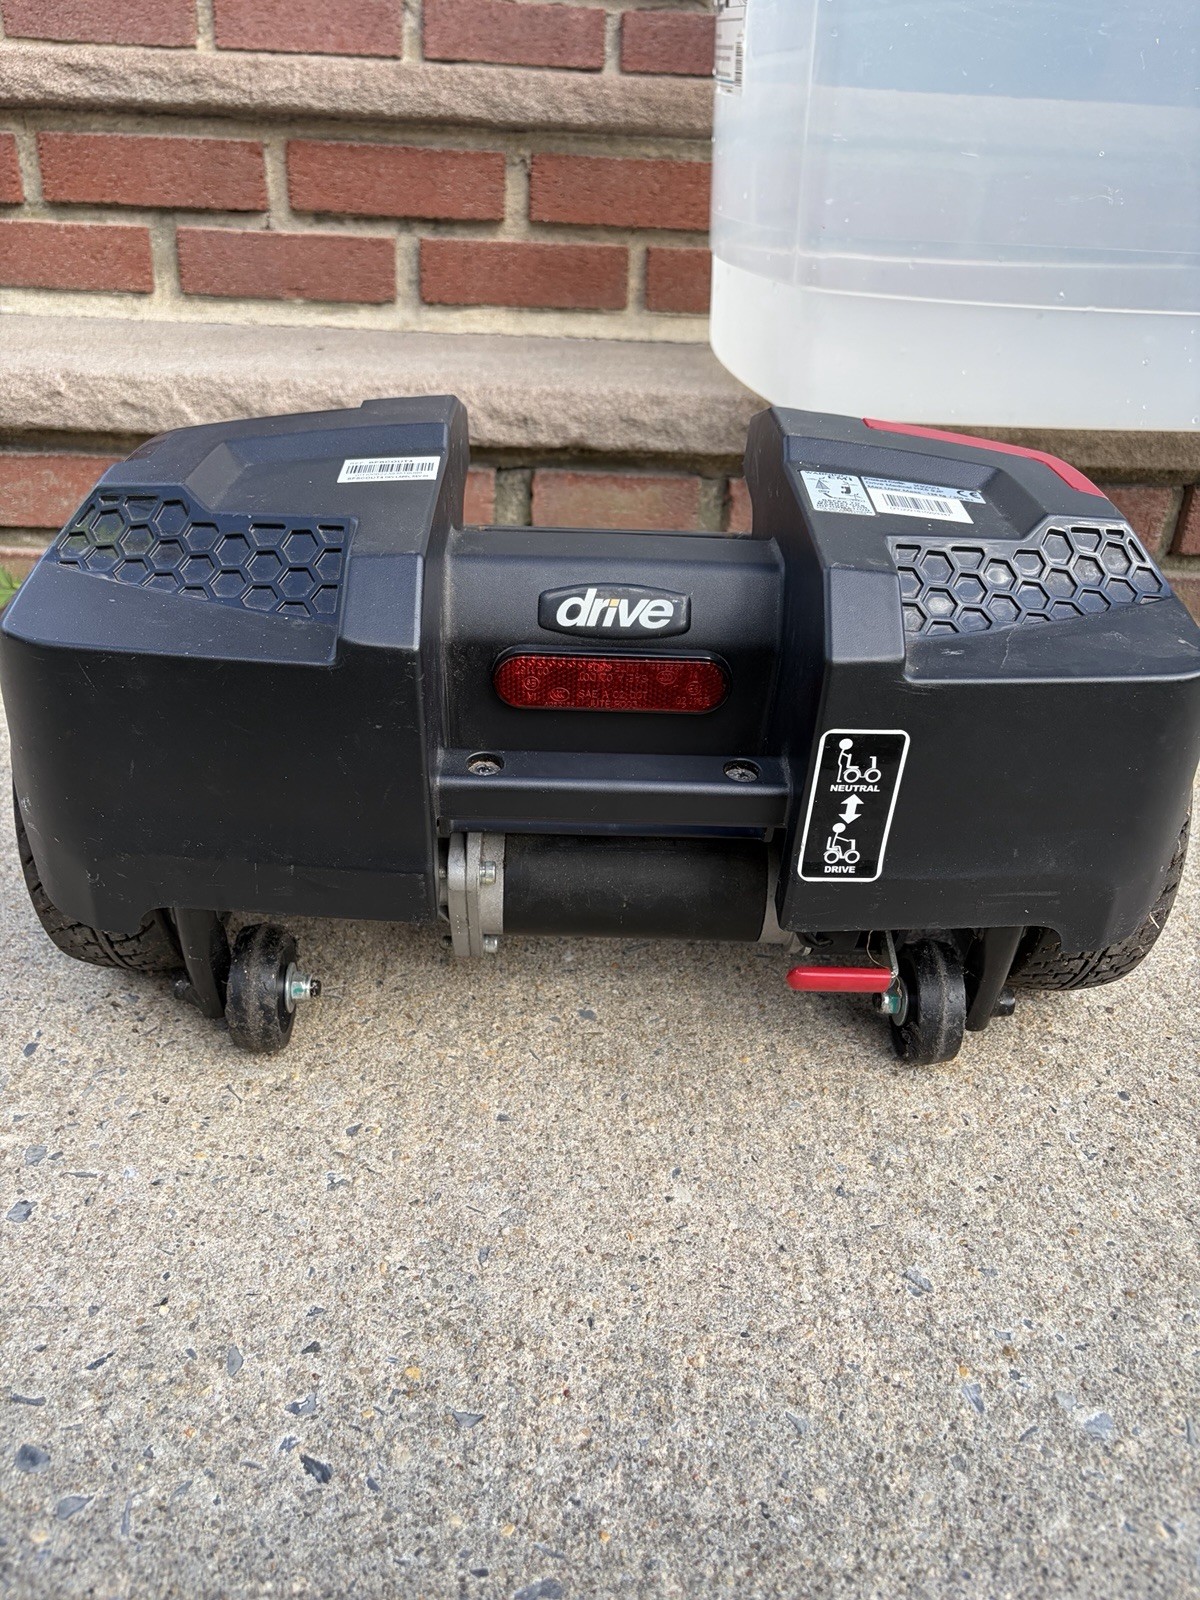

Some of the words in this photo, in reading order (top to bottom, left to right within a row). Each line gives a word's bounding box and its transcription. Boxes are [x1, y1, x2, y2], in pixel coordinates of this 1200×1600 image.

[556, 588, 674, 629] drive
[830, 784, 880, 792] NEUTRAL
[824, 865, 856, 874] DRIVE
